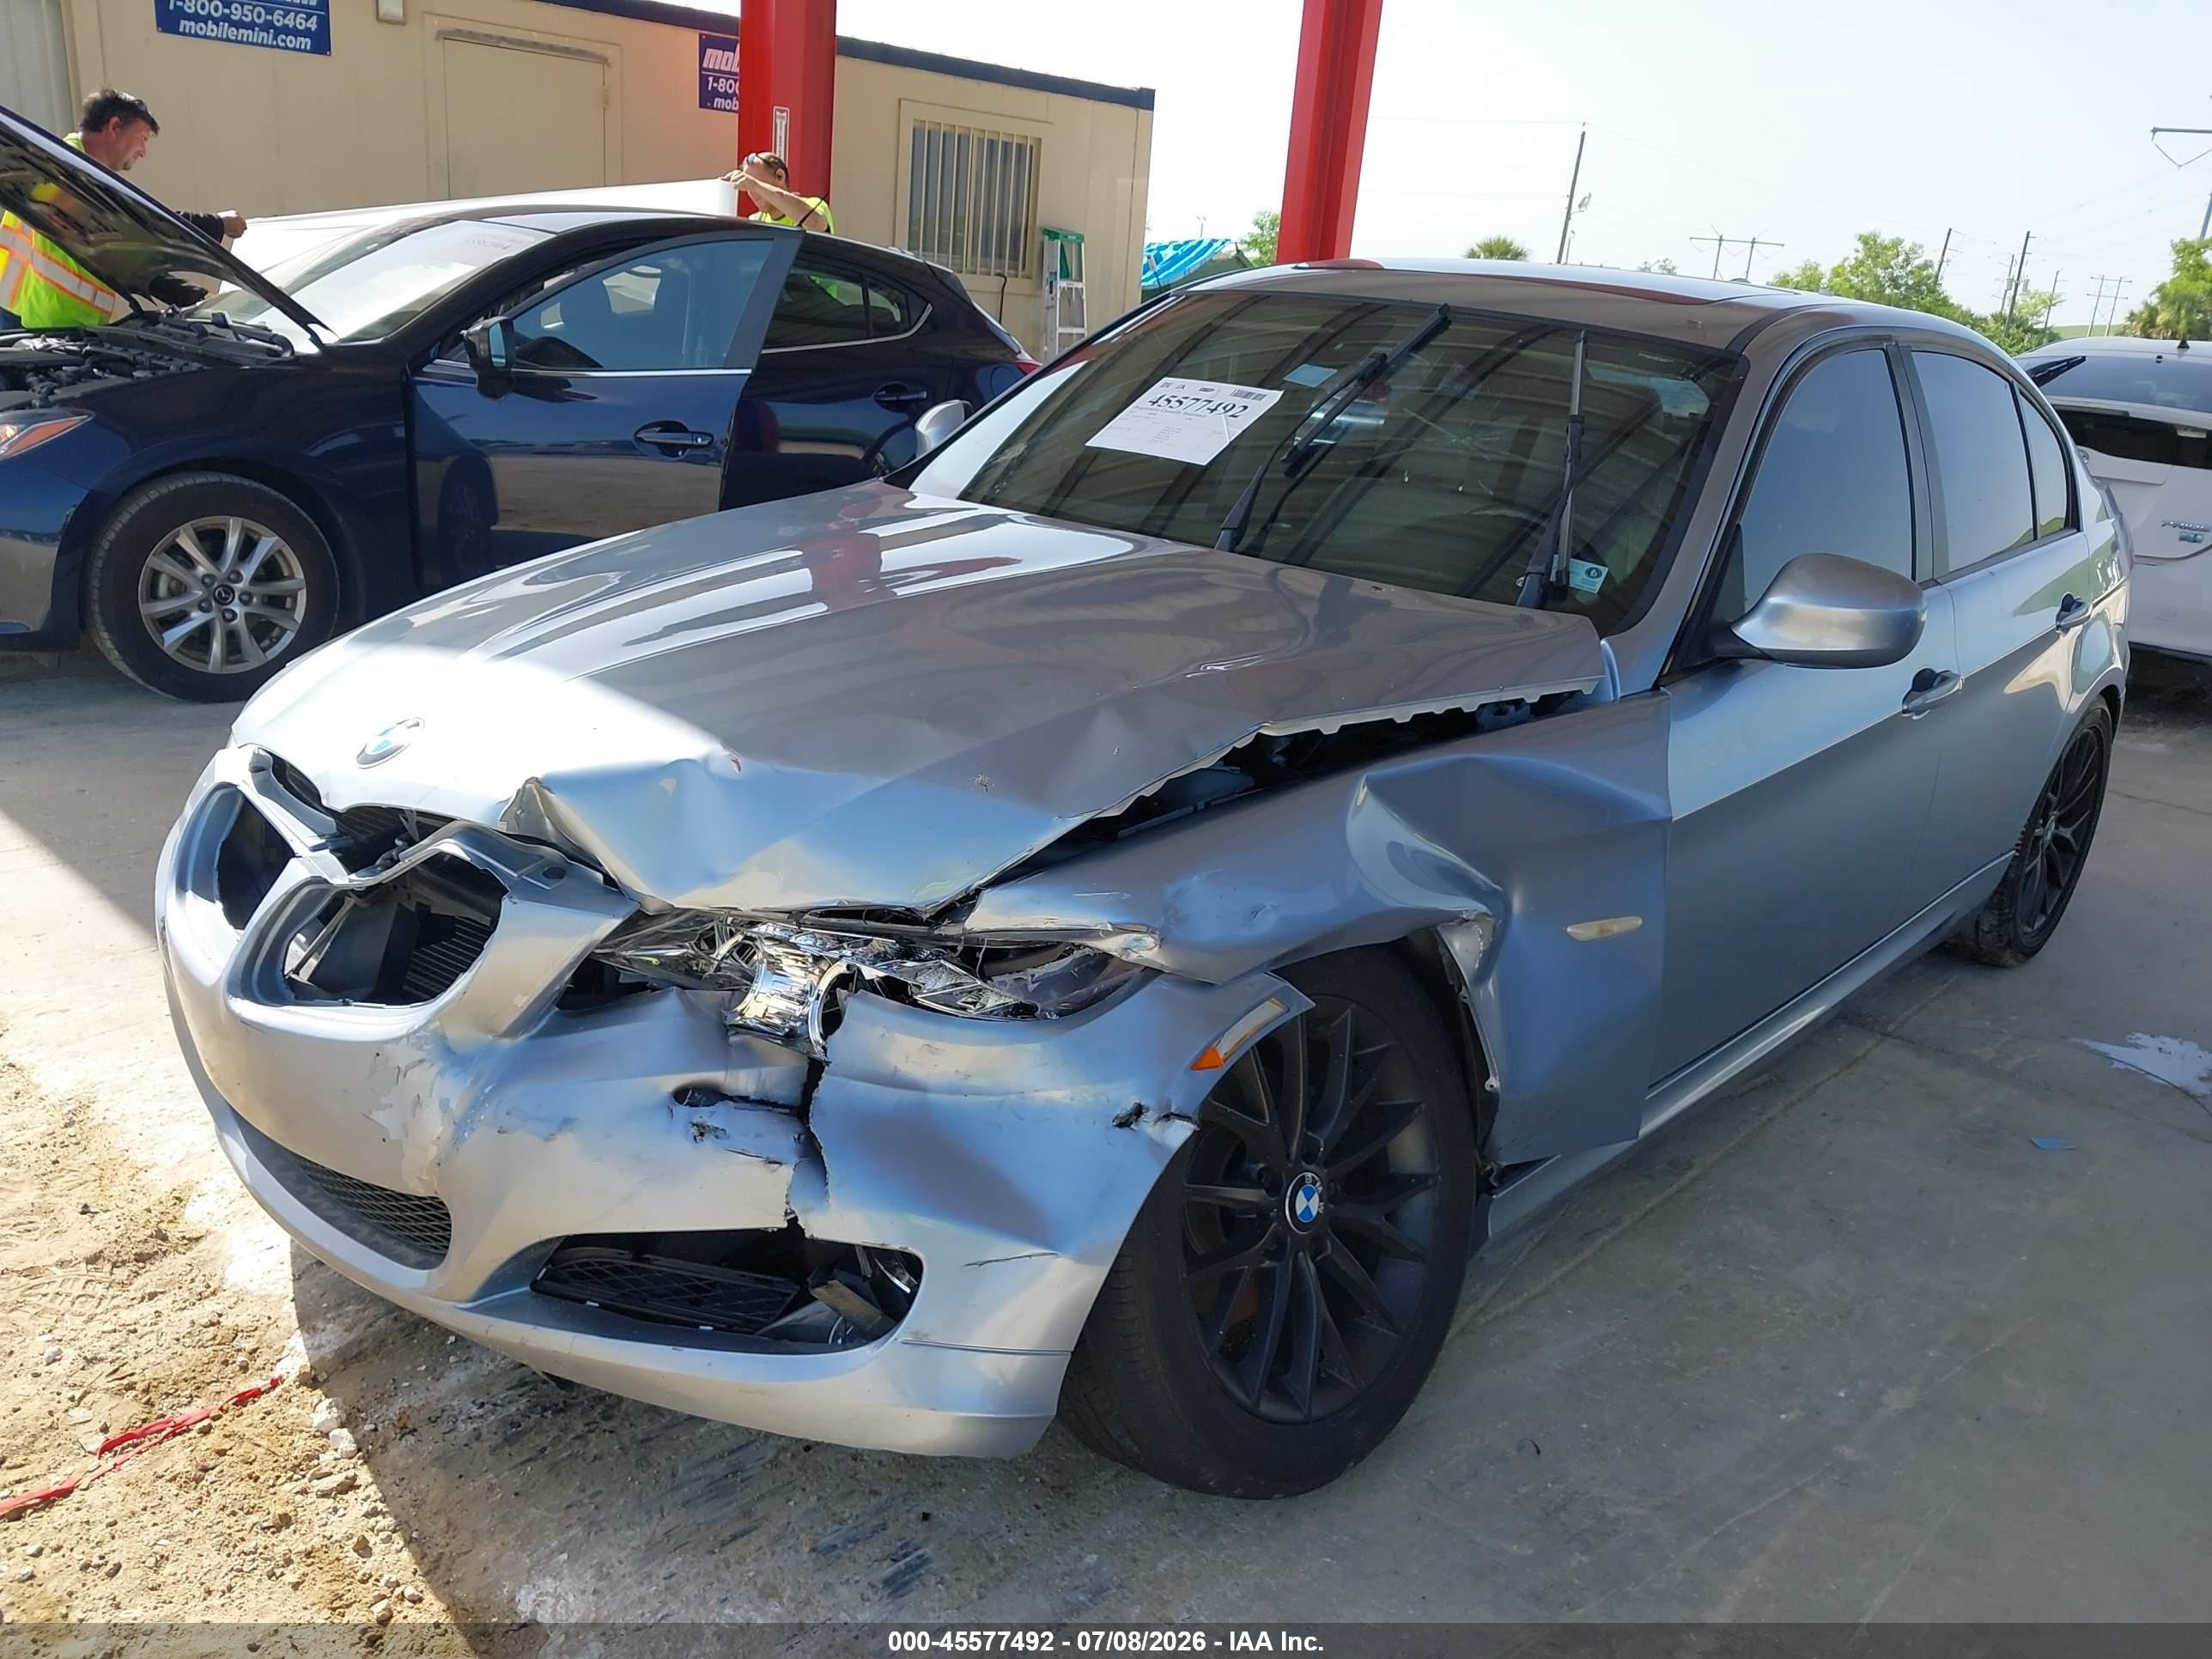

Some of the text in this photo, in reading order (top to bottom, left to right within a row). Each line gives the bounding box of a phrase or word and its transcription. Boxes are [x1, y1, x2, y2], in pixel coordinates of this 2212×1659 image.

[169, 0, 318, 32] 1-800-950-6464
[179, 19, 311, 50] mobilemini.com
[1147, 393, 1249, 418] 45577492
